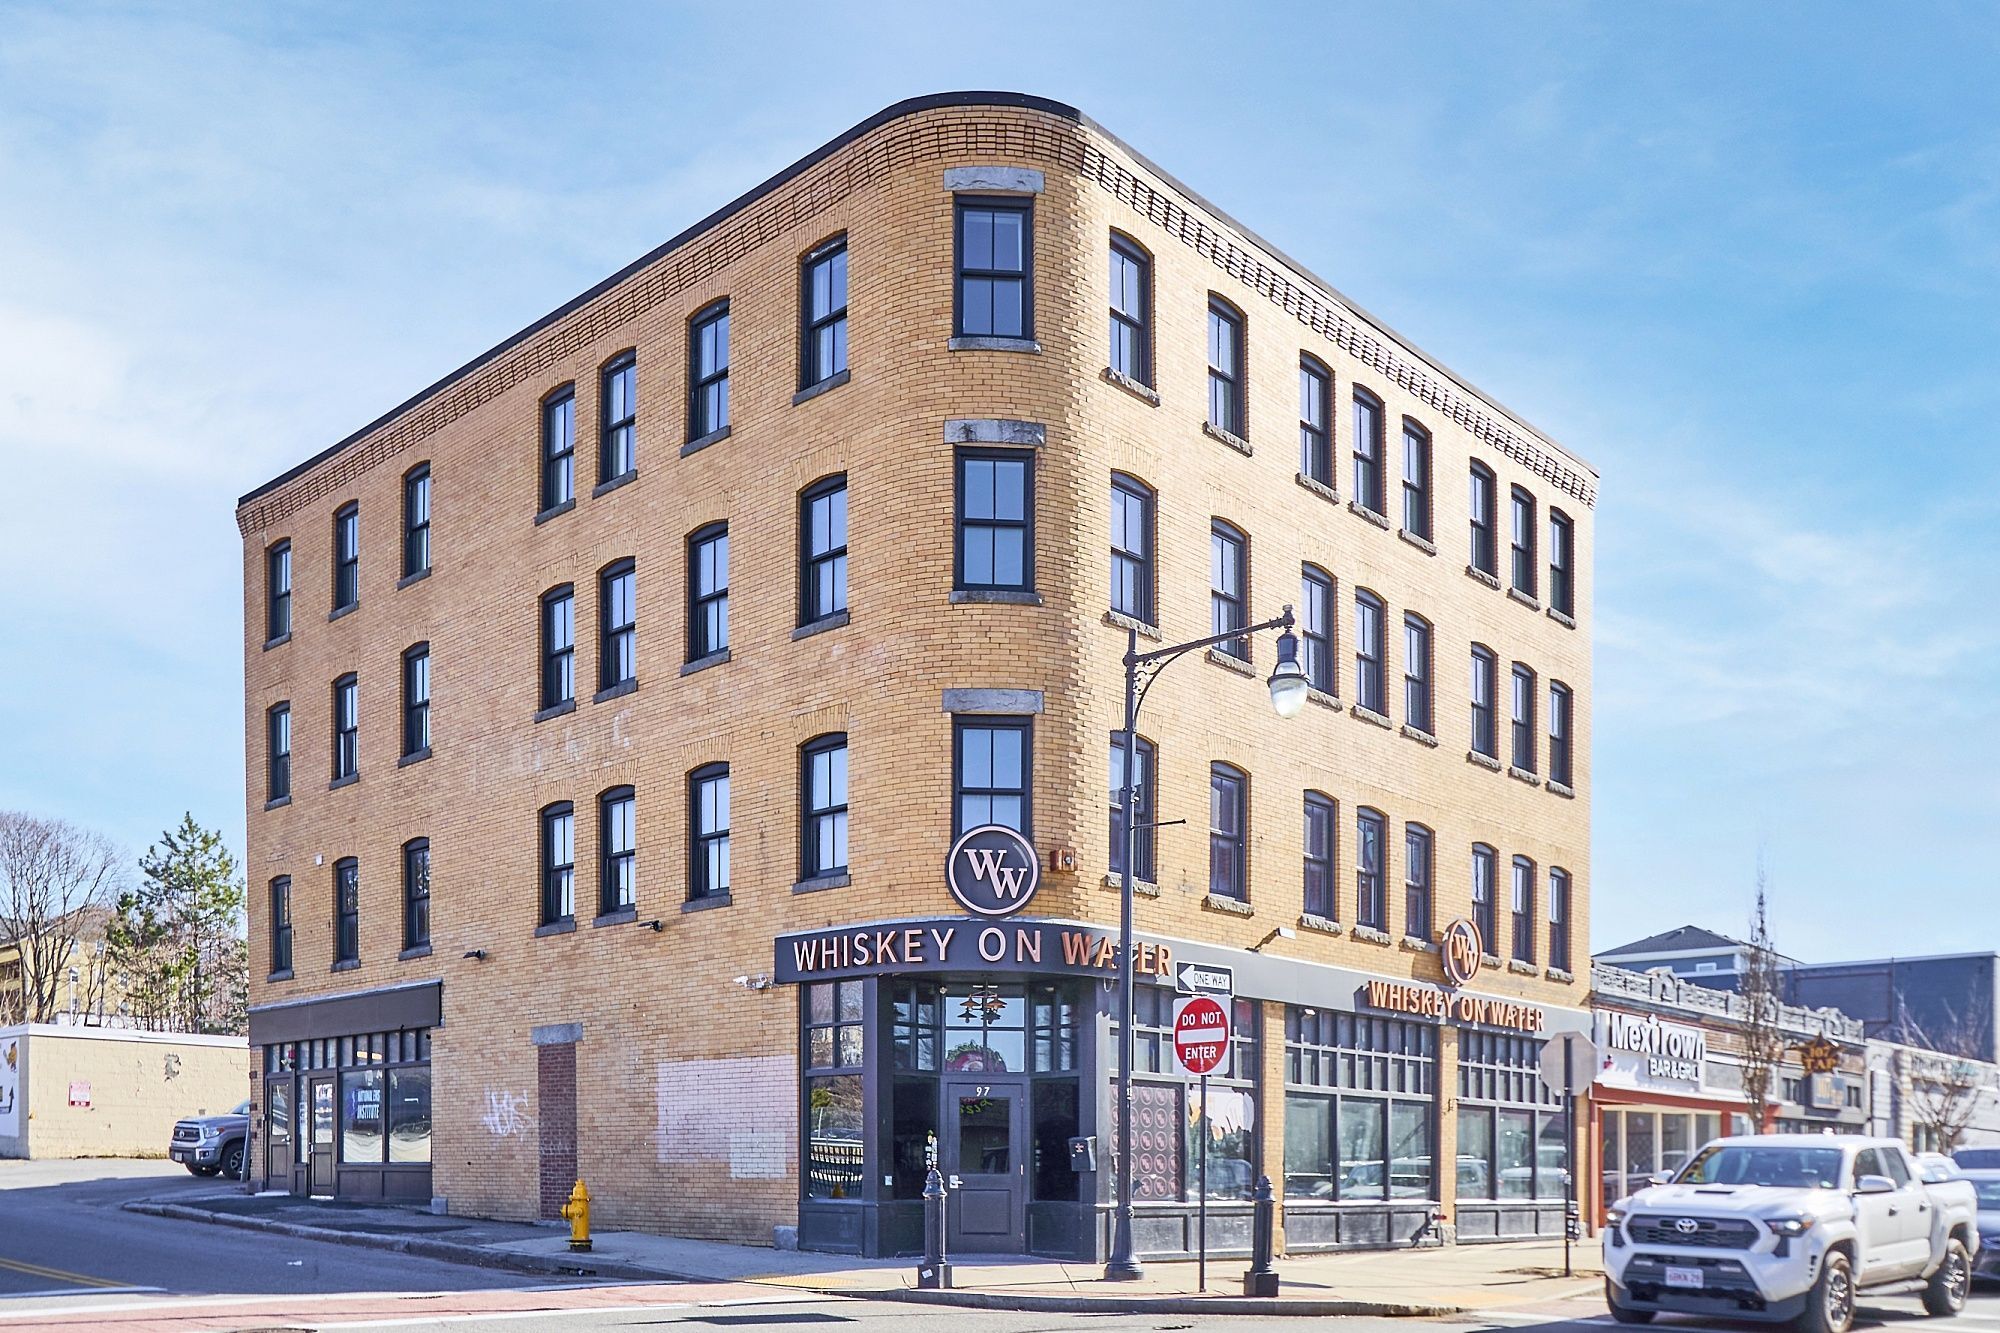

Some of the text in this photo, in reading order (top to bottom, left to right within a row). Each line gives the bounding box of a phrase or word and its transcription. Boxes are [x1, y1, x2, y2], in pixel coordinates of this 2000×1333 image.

[963, 849, 1028, 899] WW
[793, 927, 1172, 977] WHISKEY ON WAER
[1194, 974, 1228, 987] ONE WAY
[1368, 980, 1545, 1031] WHISKEY ON WATER
[1182, 1011, 1222, 1026] DO NOT
[1185, 1045, 1217, 1060] ENTER
[976, 1086, 990, 1097] 97
